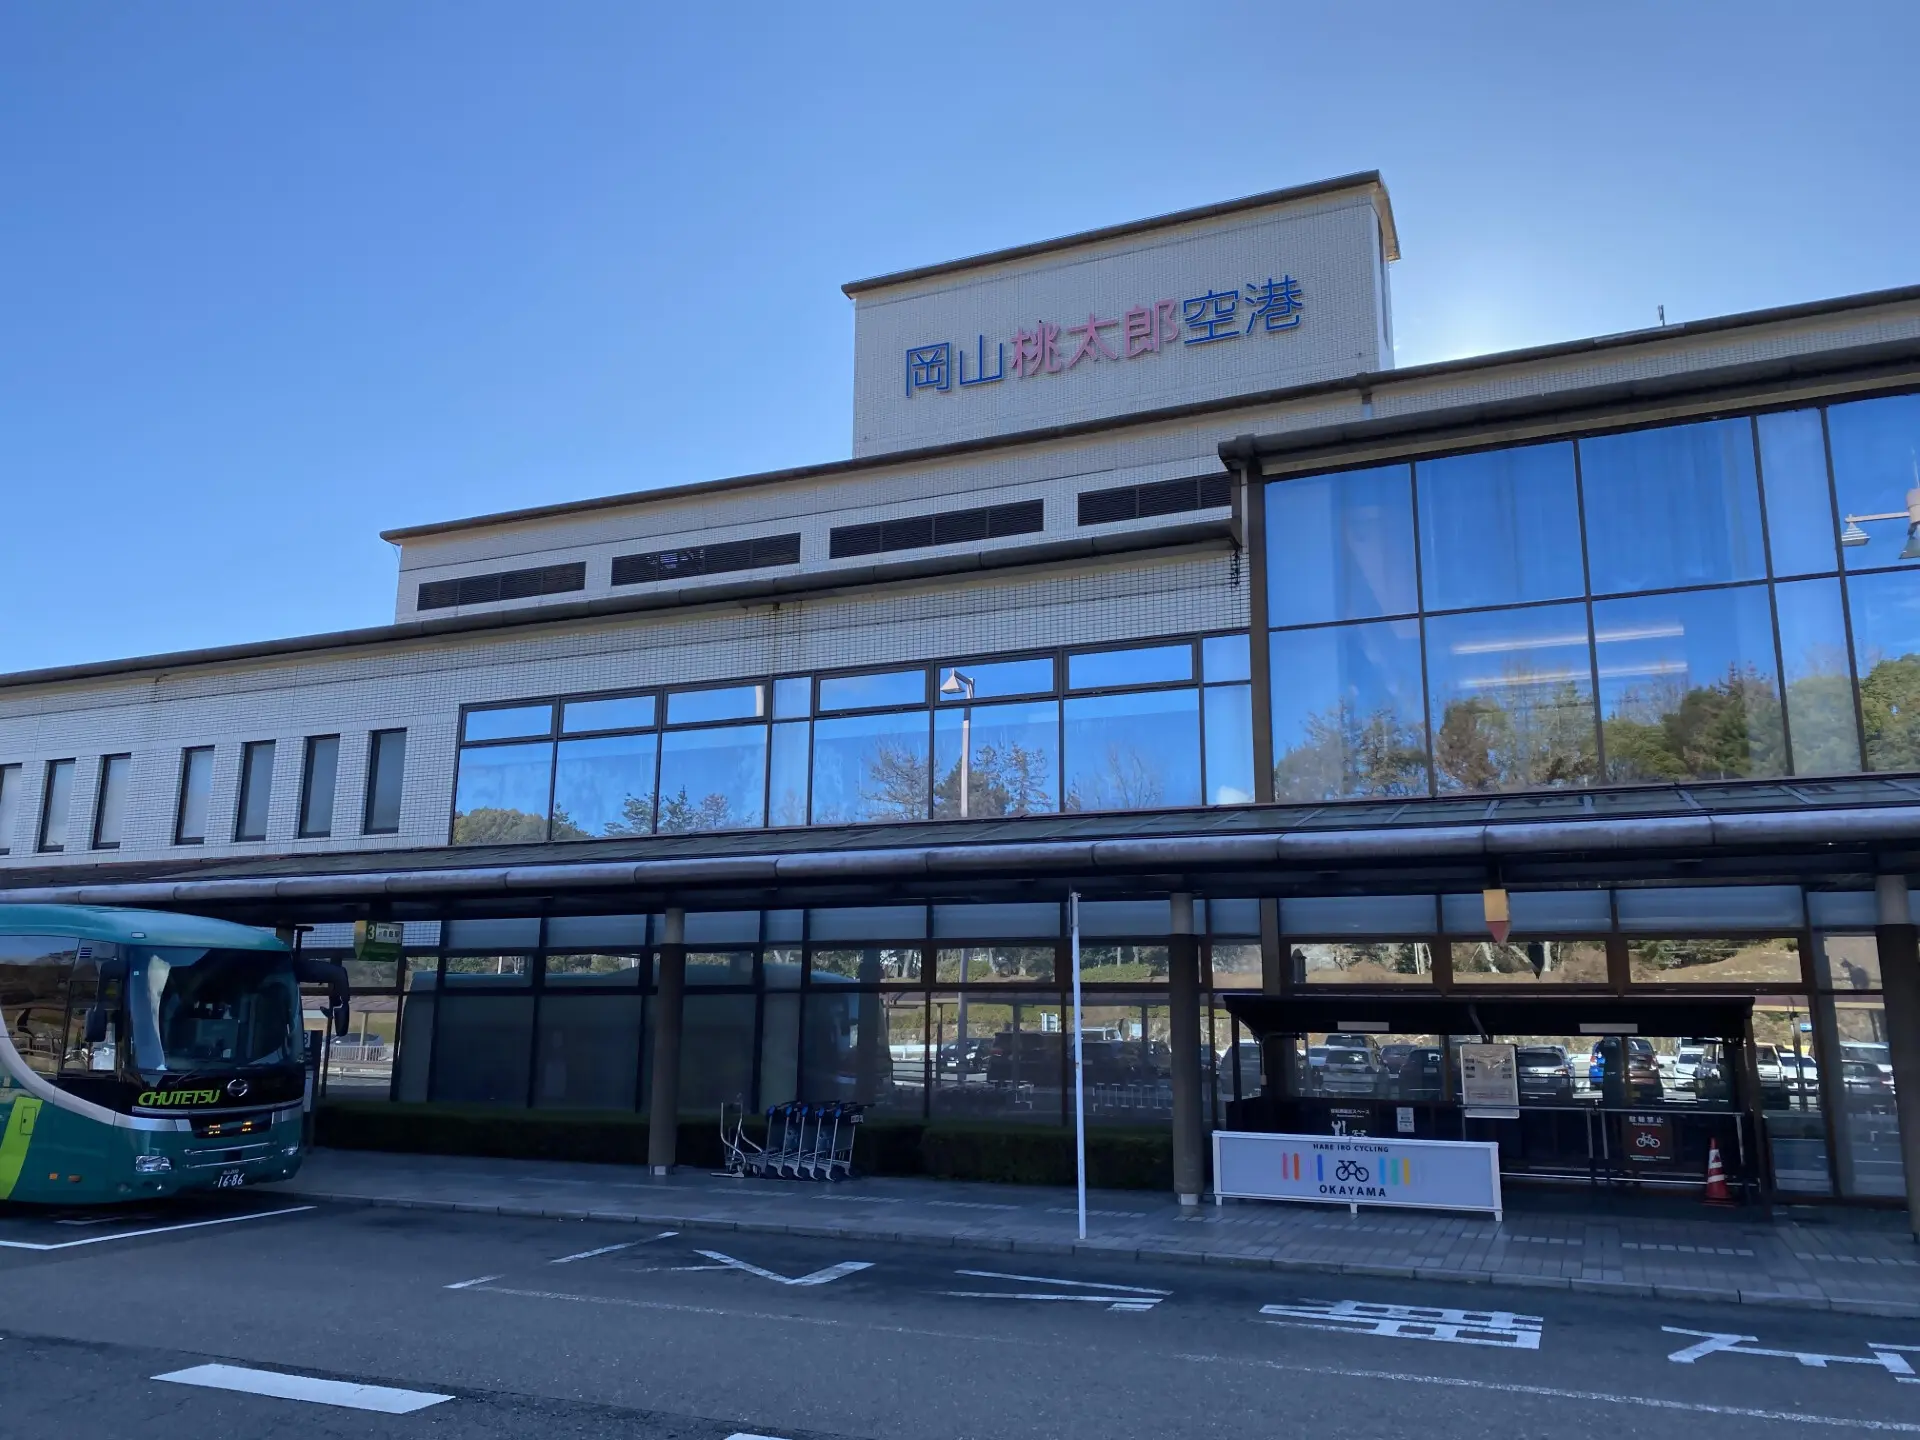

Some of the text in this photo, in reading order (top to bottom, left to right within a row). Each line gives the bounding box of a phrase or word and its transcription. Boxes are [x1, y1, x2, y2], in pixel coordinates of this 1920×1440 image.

[905, 274, 1304, 397] 岡山桃太郎空港
[367, 924, 376, 940] 3
[138, 1089, 221, 1106] CHUTETSU
[1354, 1145, 1389, 1153] CYCLING
[1319, 1184, 1387, 1197] OKAYAMA
